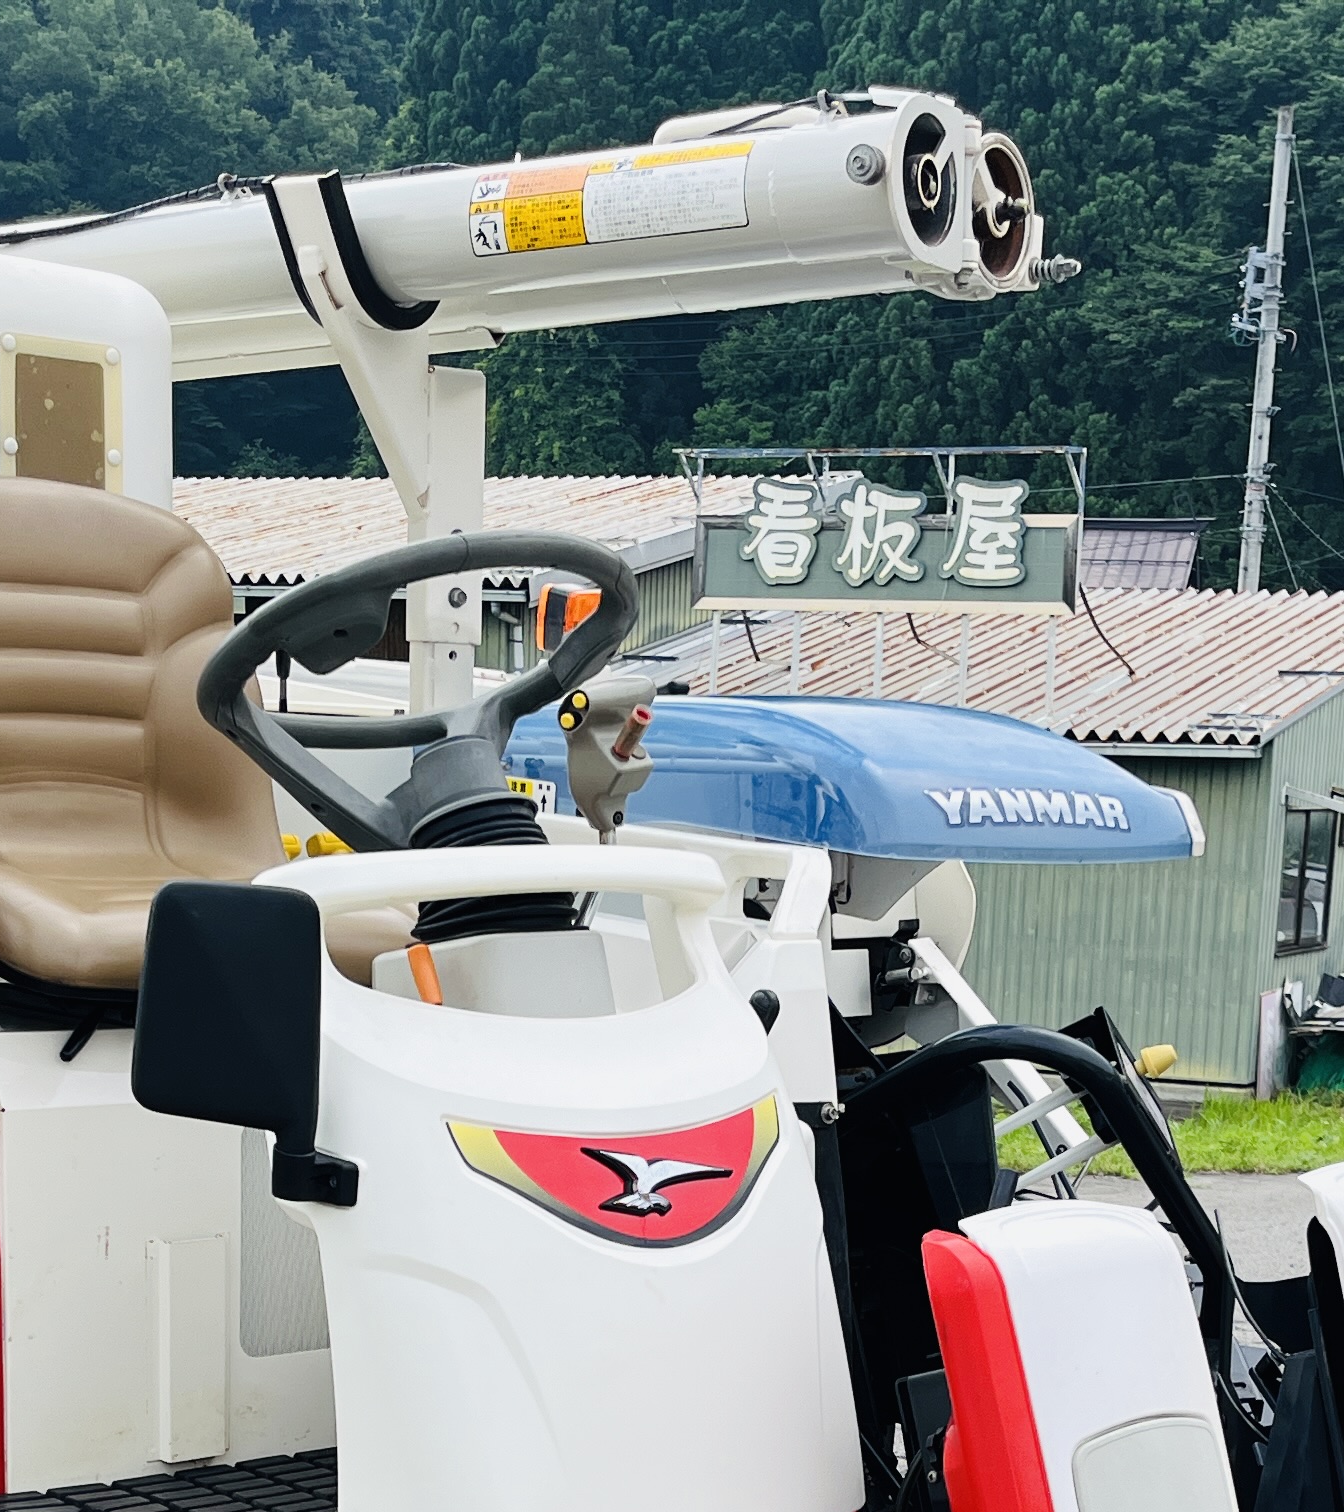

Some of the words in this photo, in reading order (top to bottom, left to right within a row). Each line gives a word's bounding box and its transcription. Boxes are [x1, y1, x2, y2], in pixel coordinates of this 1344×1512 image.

[741, 477, 1026, 584] 看板屋
[923, 787, 1131, 832] YANMAR
